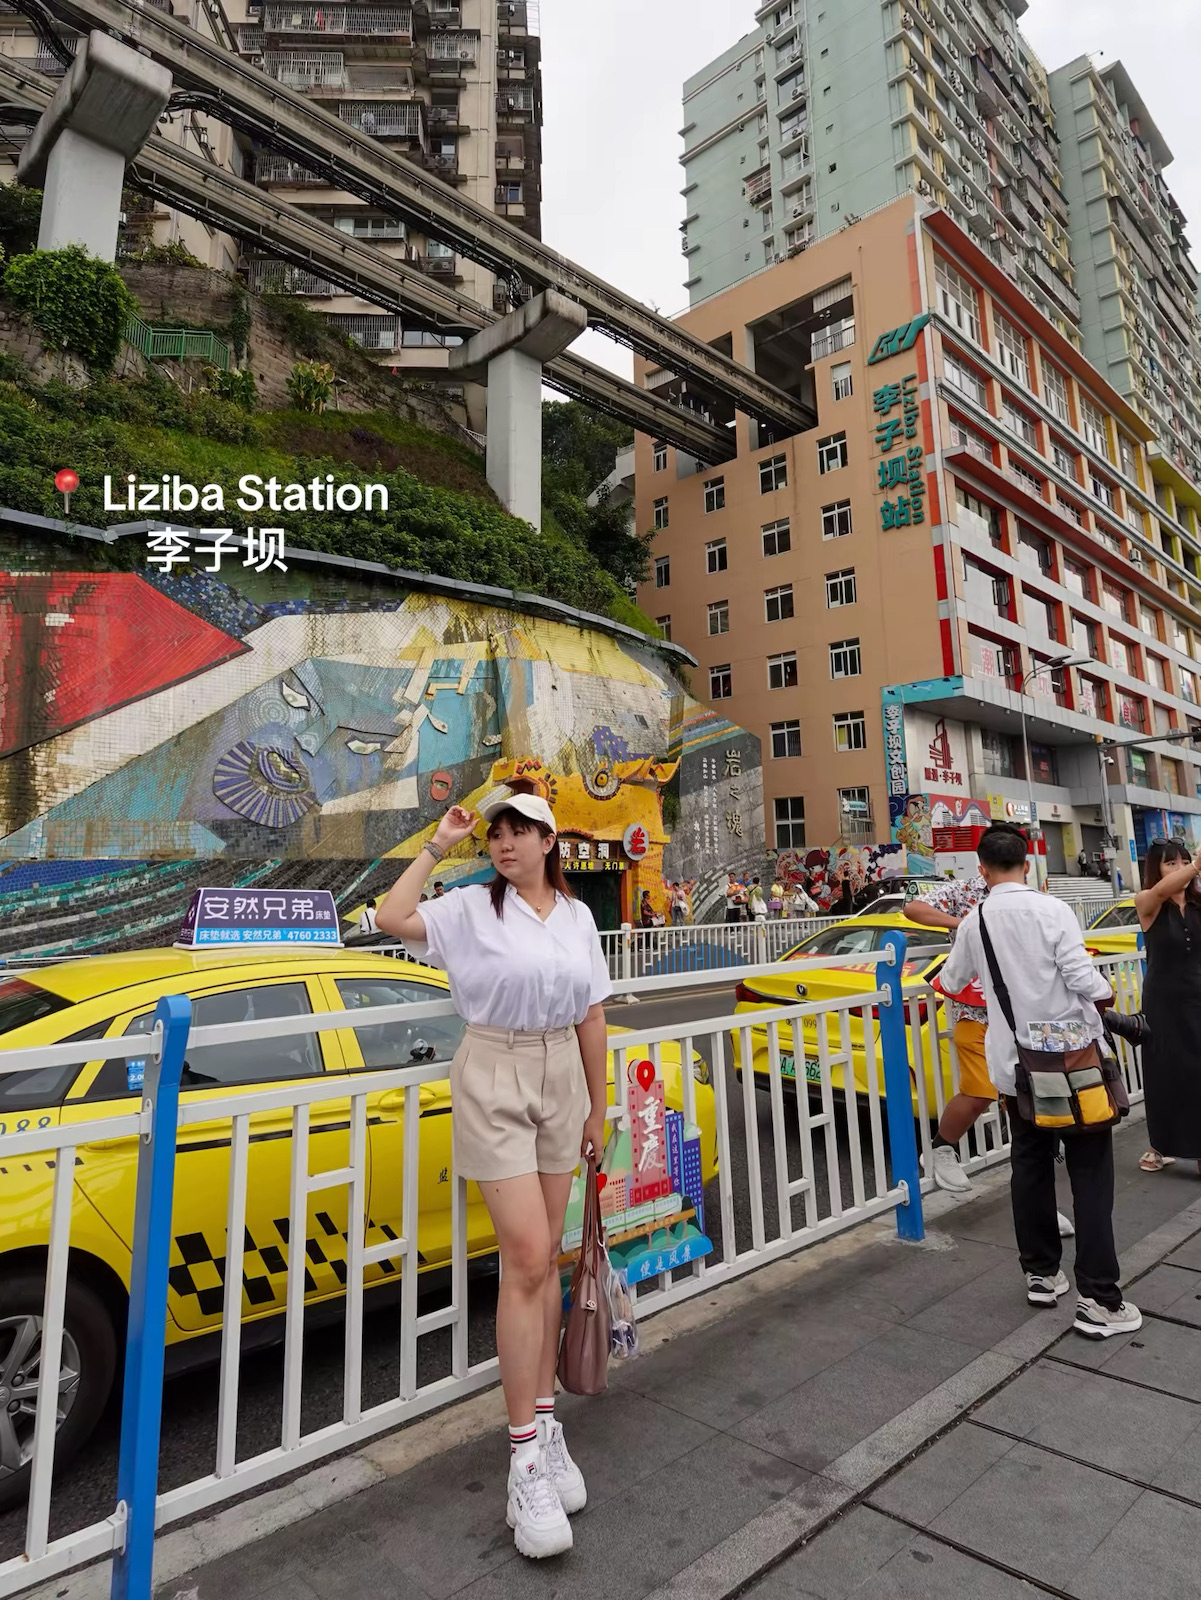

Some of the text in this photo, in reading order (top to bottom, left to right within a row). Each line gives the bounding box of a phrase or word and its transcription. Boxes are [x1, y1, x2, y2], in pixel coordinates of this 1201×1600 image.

[873, 383, 911, 531] 李子坝站
[907, 446, 925, 524] Station
[884, 705, 906, 794] 李子坝文创园
[558, 841, 609, 859] 防空洞
[629, 827, 646, 854] 岩
[204, 896, 331, 921] 安然兄弟 床垫
[199, 930, 240, 941] 床垫就选
[243, 930, 282, 941] 安然兄弟
[287, 931, 311, 941] 4760
[313, 930, 336, 940] 2333
